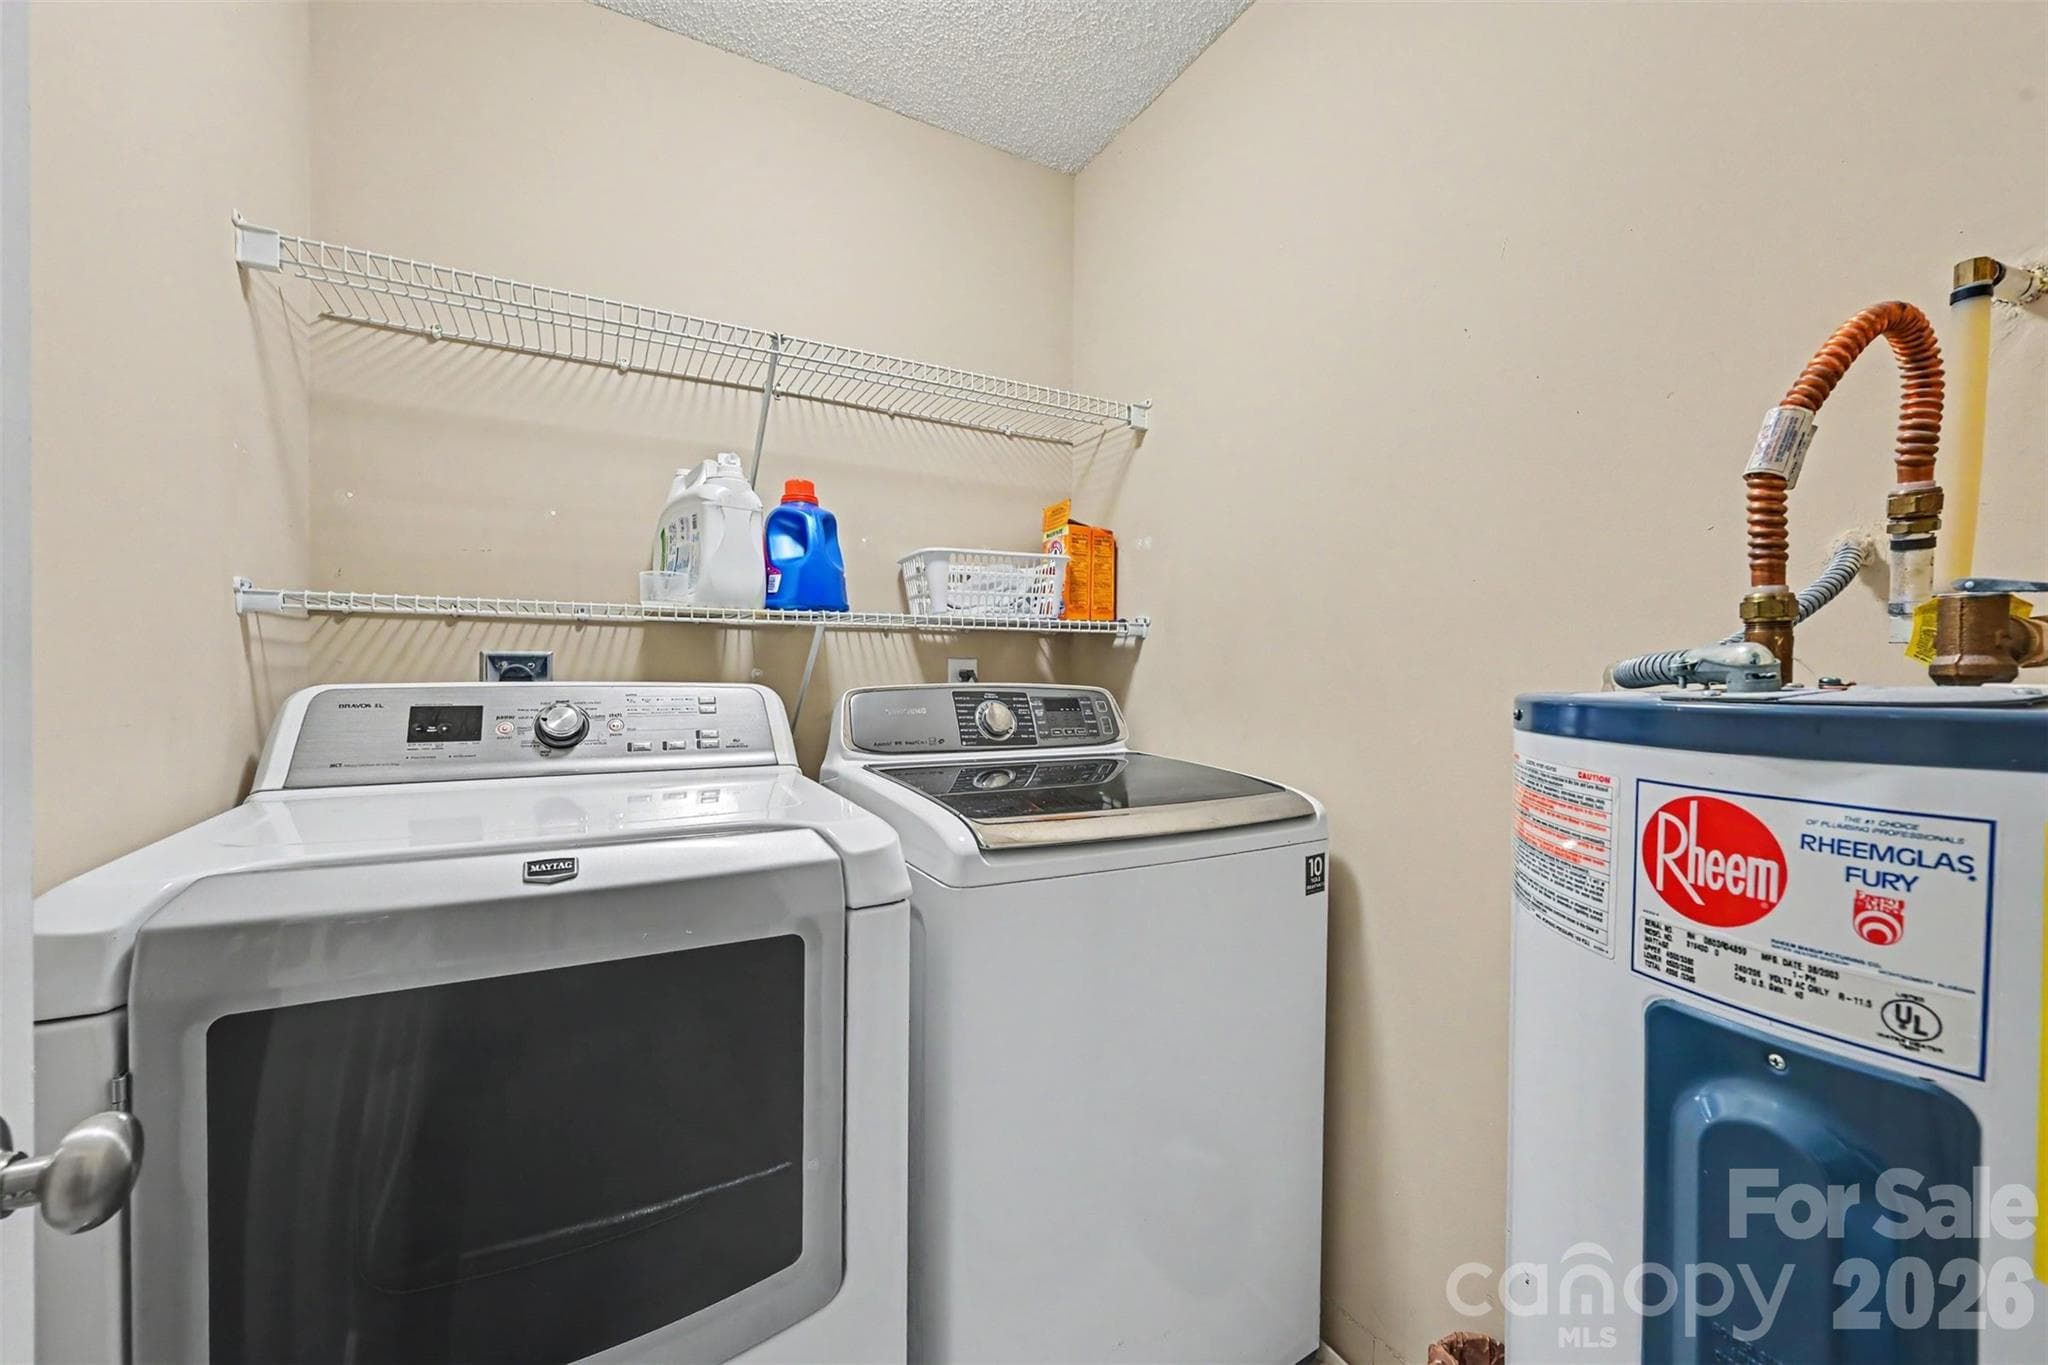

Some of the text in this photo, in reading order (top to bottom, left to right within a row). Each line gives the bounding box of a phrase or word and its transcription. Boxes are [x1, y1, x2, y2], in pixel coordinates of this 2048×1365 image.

[1577, 771, 1612, 785] CAUTION
[1805, 818, 1966, 845] OF PLUMBING PROFESSIONALS
[1844, 815, 1862, 825] THE
[1878, 819, 1920, 832] CHOICE
[1655, 799, 1780, 906] Rheem
[1799, 833, 1975, 875] RHEEMGLAS
[530, 861, 573, 873] MAYTAG
[1308, 856, 1323, 878] 10
[1845, 865, 1920, 893] FURY
[1807, 983, 1831, 998] ONLY
[1895, 1002, 1929, 1038] UL
